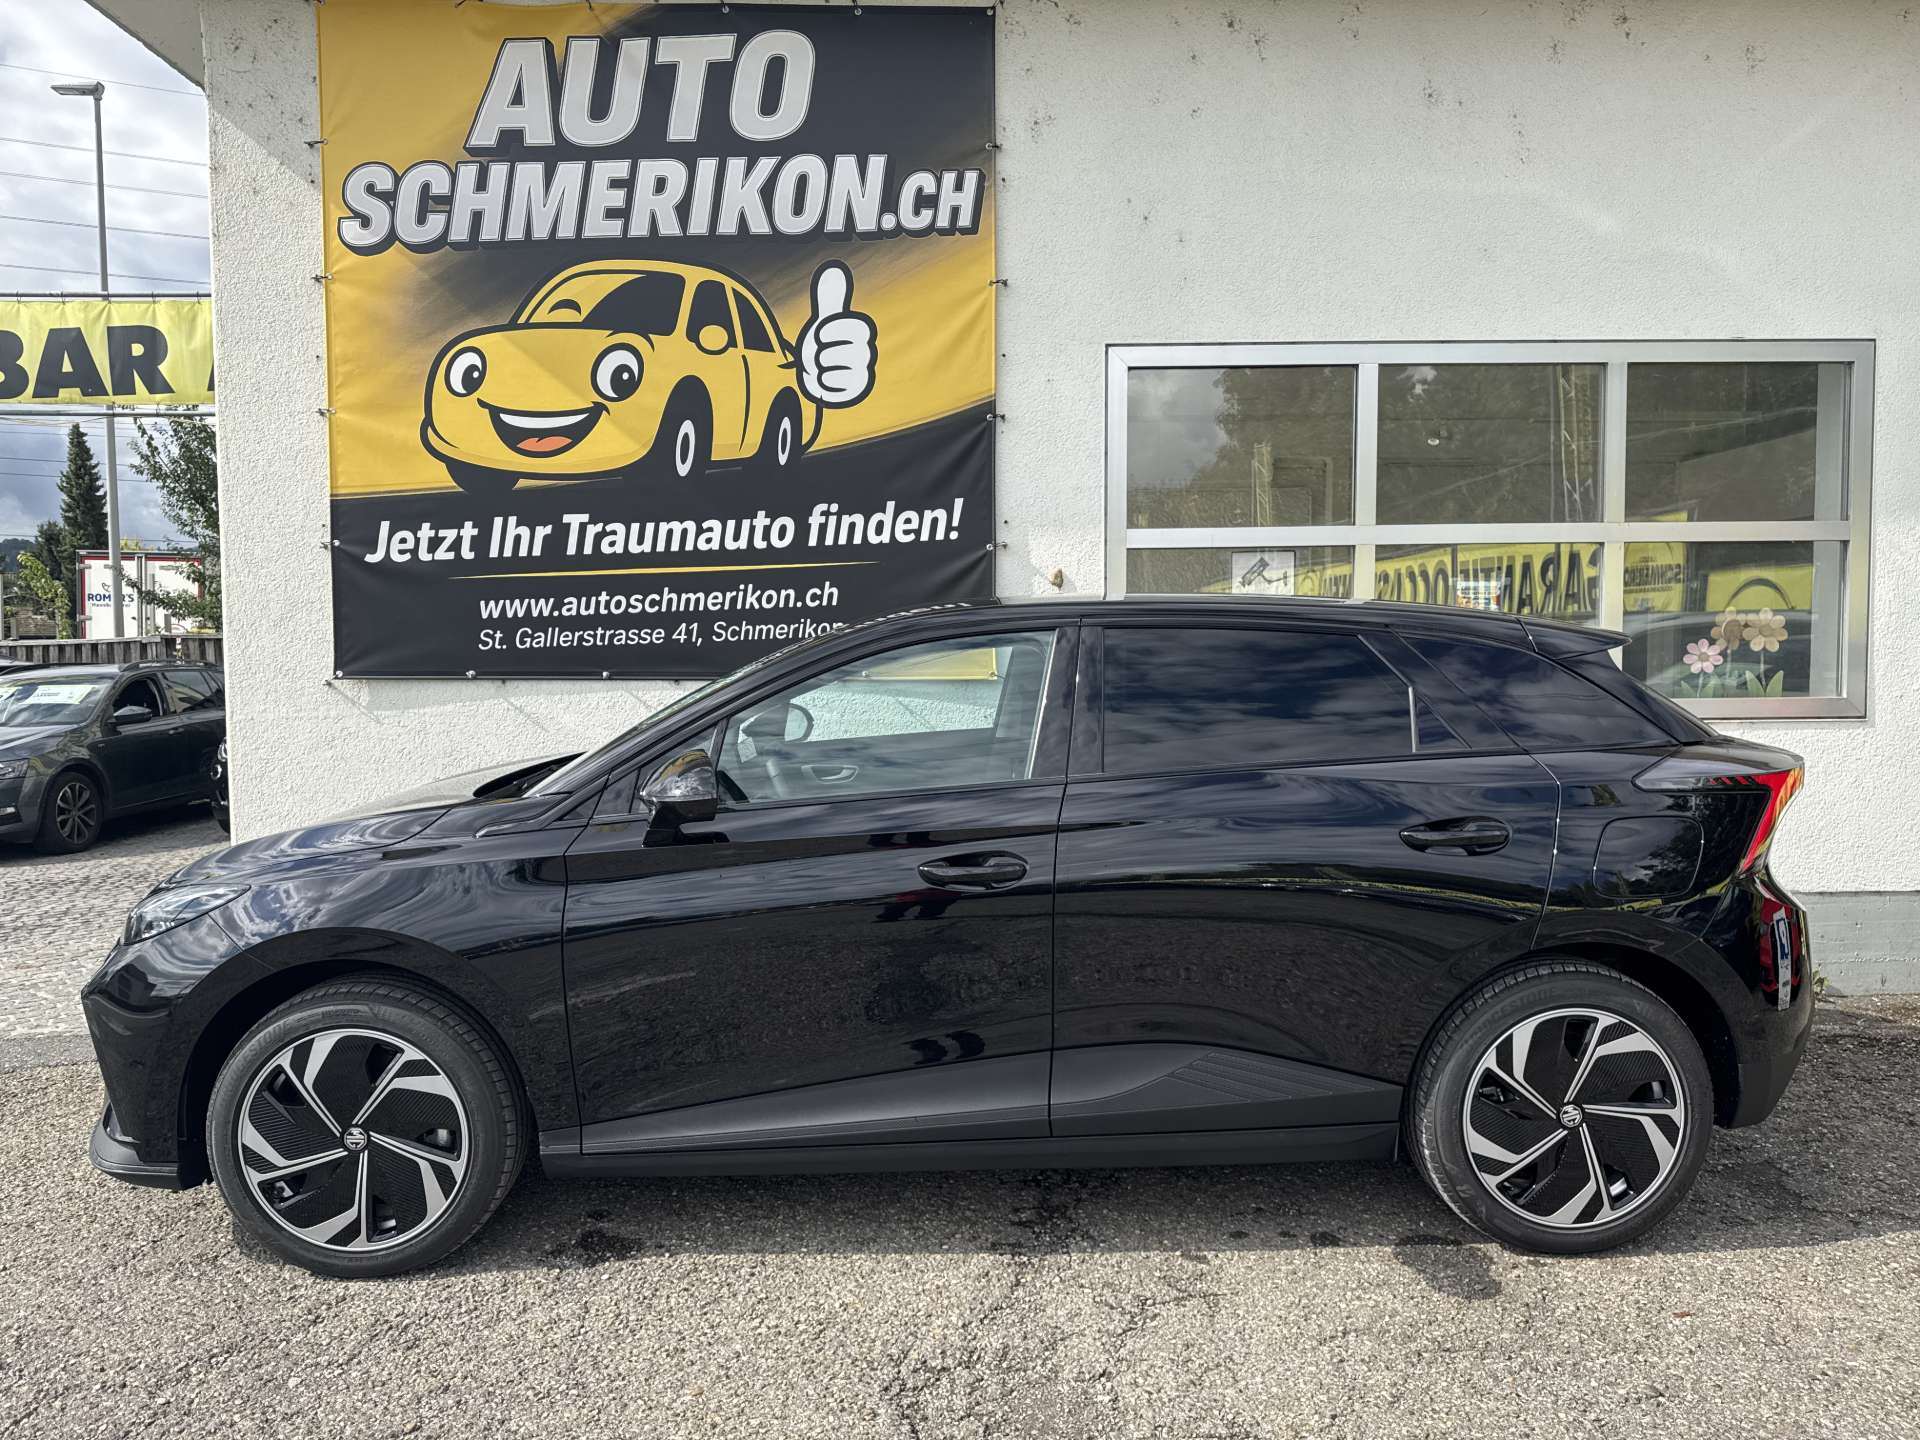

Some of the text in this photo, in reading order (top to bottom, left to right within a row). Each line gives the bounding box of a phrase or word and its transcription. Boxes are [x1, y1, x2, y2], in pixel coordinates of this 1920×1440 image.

[464, 29, 818, 149] AUTO
[337, 152, 983, 249] SCHMERIKON.CH
[364, 497, 965, 564] Jetzt Ihr Traumauto finden!
[87, 593, 135, 602] ROMR'S
[479, 580, 839, 620] www.autoschmerikon.ch
[478, 629, 507, 651] St.
[515, 625, 666, 649] Gallerstrasse
[671, 622, 703, 647] 41,
